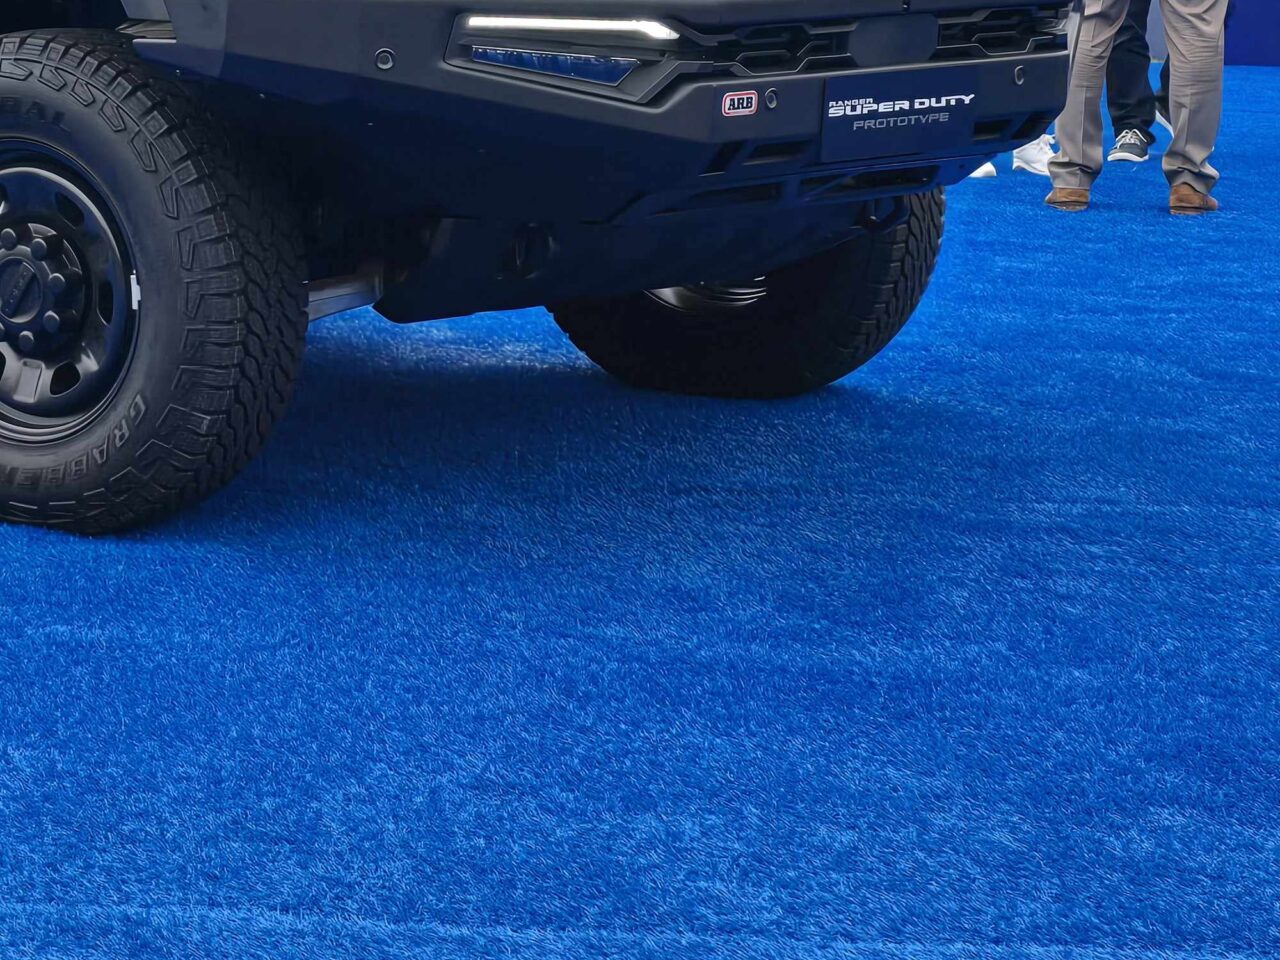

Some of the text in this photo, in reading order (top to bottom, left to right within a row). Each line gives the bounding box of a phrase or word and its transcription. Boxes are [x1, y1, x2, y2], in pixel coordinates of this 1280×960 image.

[727, 96, 754, 111] ARB
[828, 97, 874, 108] RANGER
[828, 93, 976, 117] SUPER DUTY
[852, 112, 950, 131] PROTOTYPE
